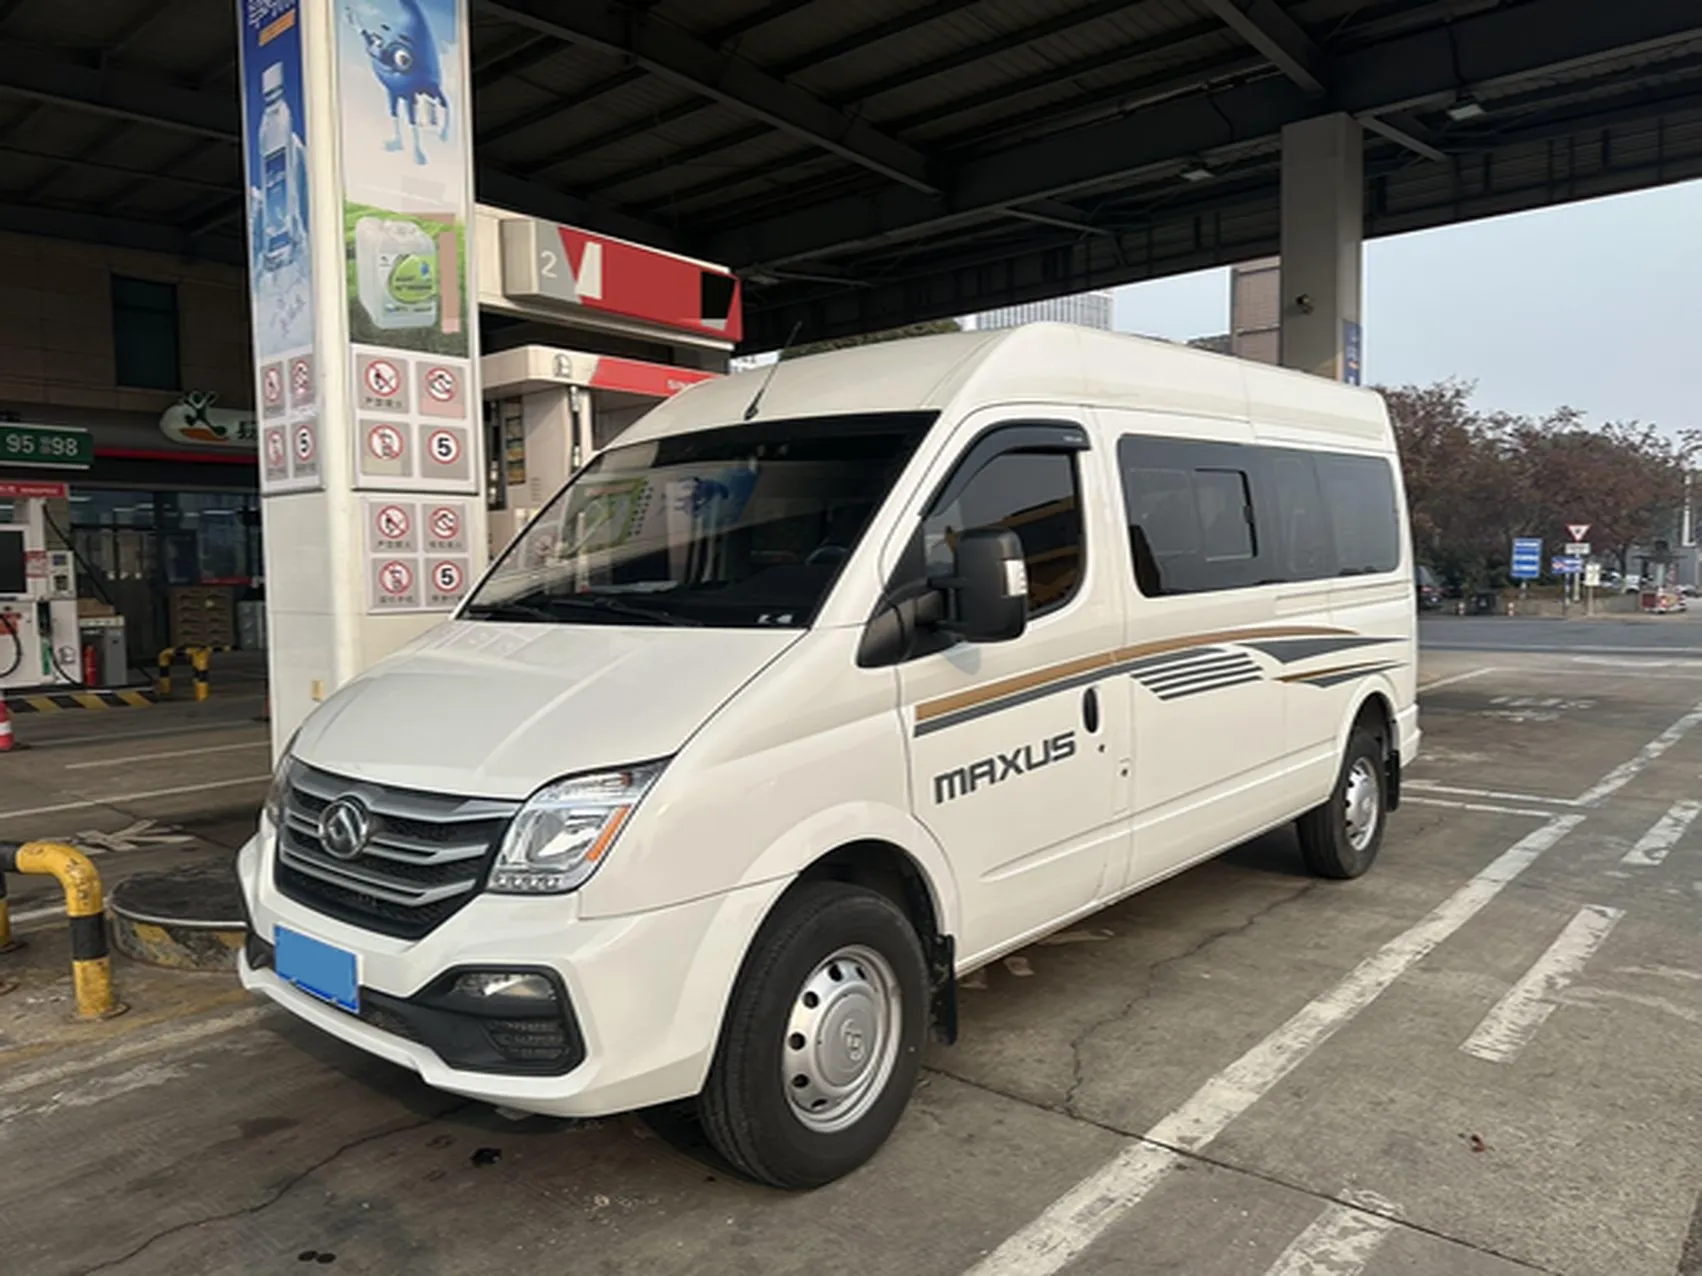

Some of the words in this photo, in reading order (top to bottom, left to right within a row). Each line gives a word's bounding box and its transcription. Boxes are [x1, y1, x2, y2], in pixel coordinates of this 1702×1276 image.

[540, 250, 558, 278] 2
[6, 433, 35, 454] 95
[52, 436, 78, 457] 98
[437, 437, 453, 457] 5
[441, 567, 455, 586] 5
[933, 730, 1076, 805] MAXUS
